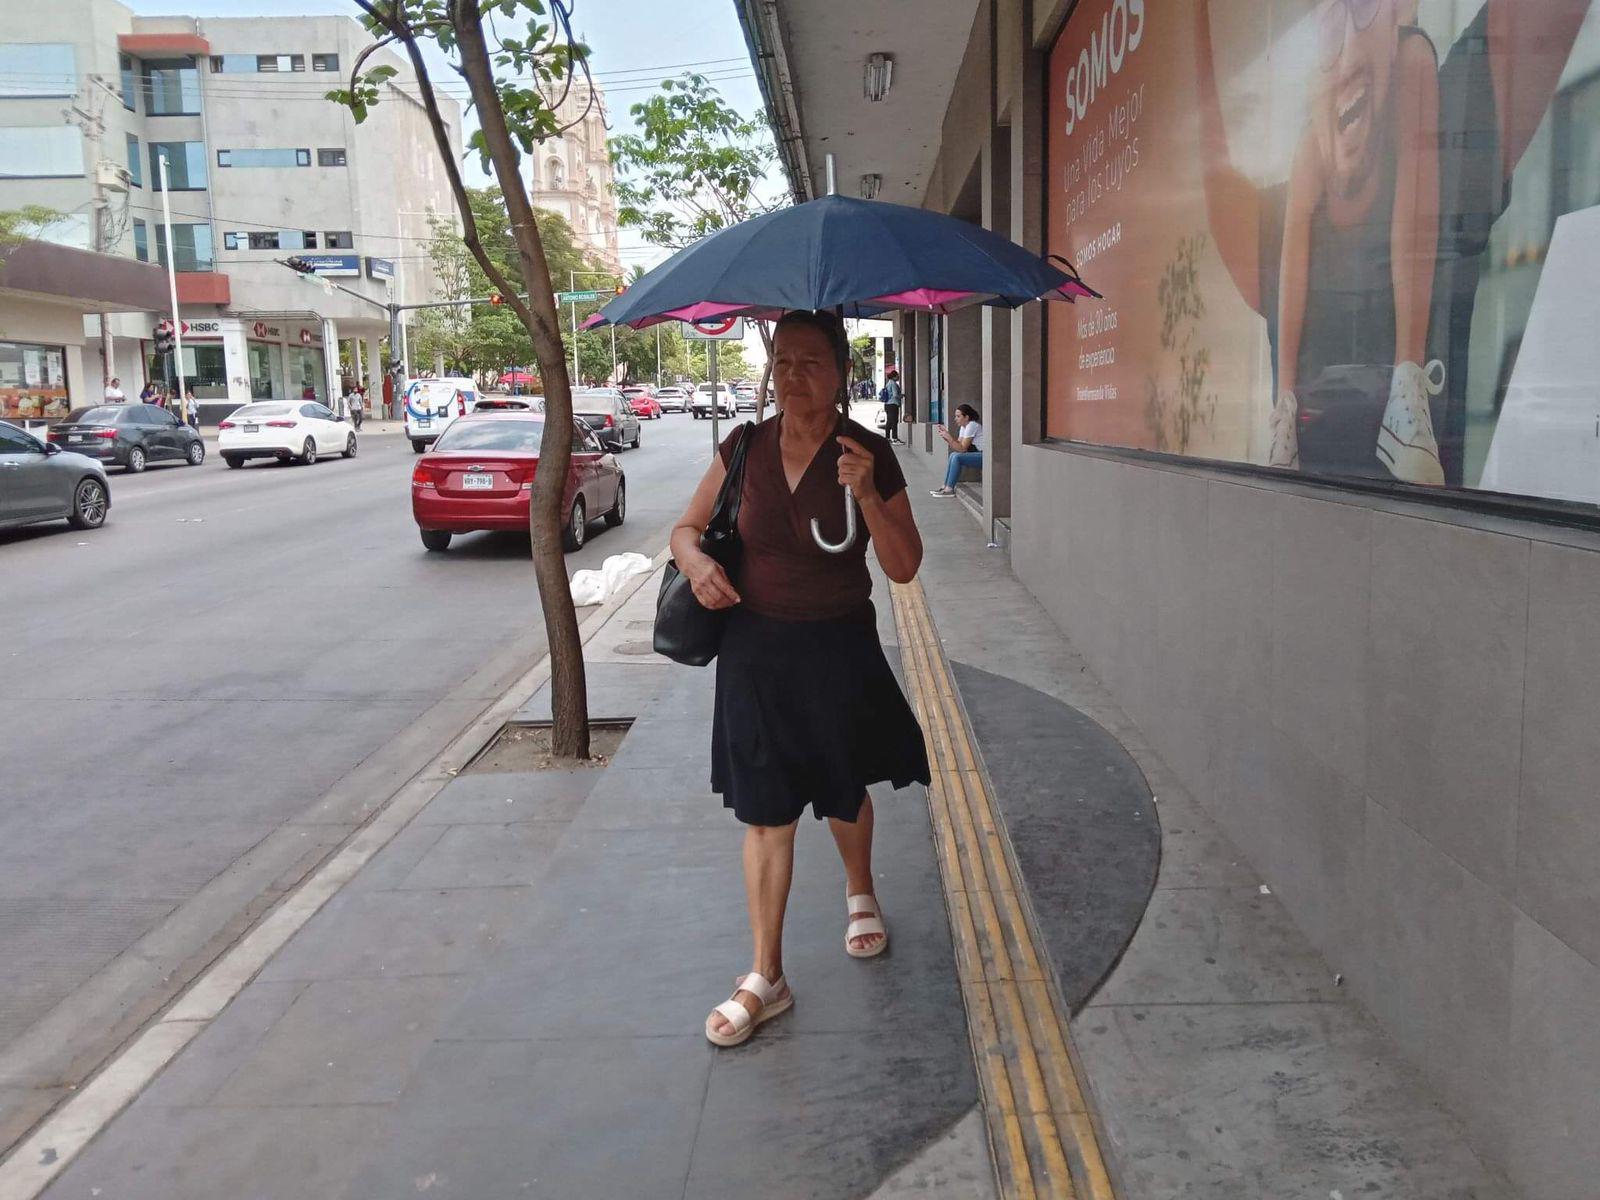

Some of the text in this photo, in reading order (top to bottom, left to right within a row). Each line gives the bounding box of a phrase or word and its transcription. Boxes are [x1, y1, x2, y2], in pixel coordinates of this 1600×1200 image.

[1065, 0, 1144, 135] SOMOS
[1064, 82, 1144, 193] Una Vida Mejor
[1066, 137, 1139, 236] para los tuyos
[1075, 222, 1121, 269] SOMOS HOGAR
[190, 322, 219, 332] HSBC
